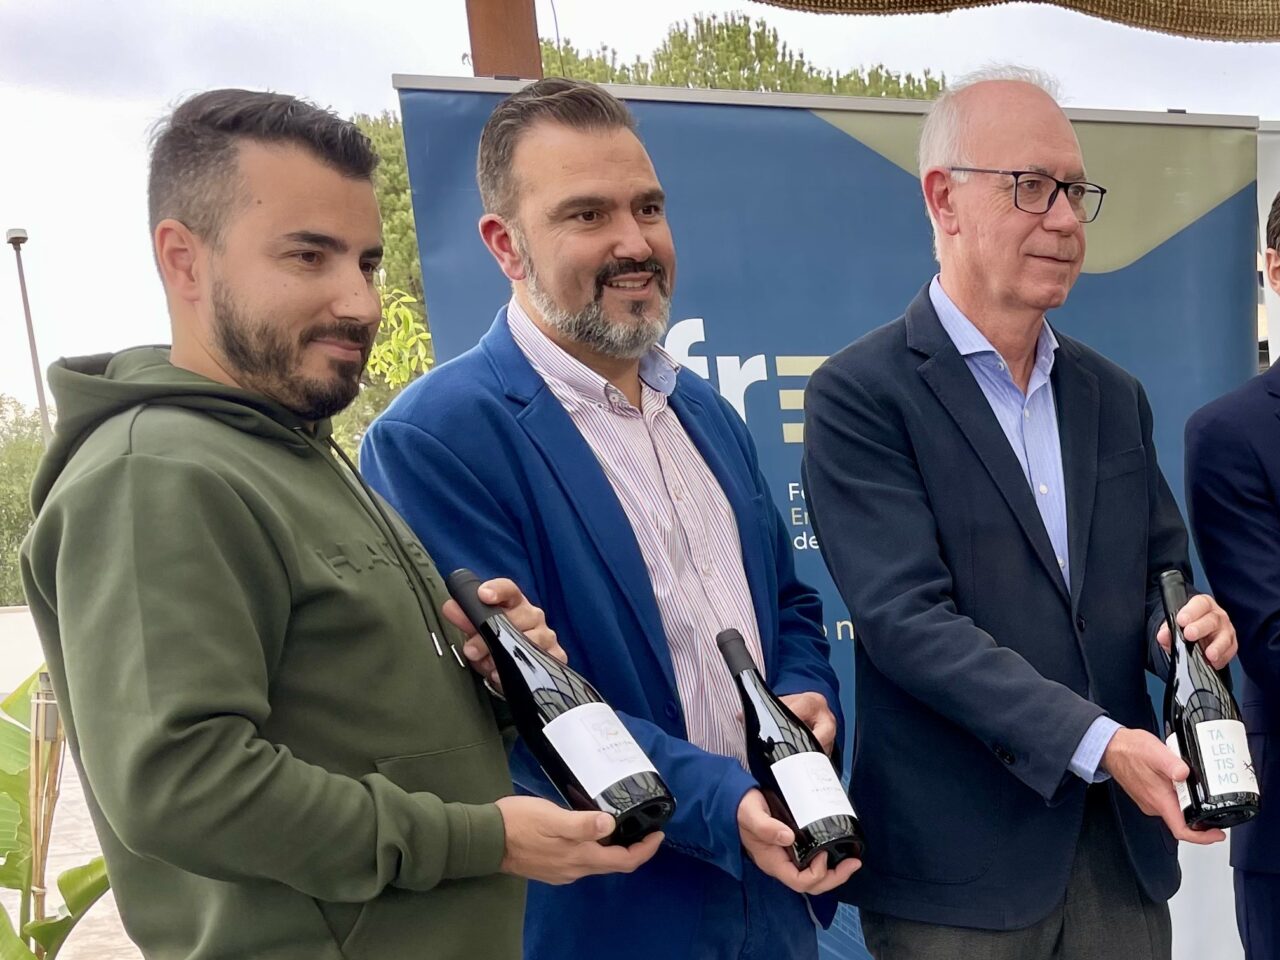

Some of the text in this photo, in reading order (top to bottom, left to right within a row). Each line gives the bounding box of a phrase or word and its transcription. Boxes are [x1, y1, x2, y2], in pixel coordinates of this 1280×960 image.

[1208, 729, 1224, 740] TA
[1211, 743, 1235, 756] LEN
[1214, 758, 1235, 770] TIS
[1217, 772, 1239, 785] MO
